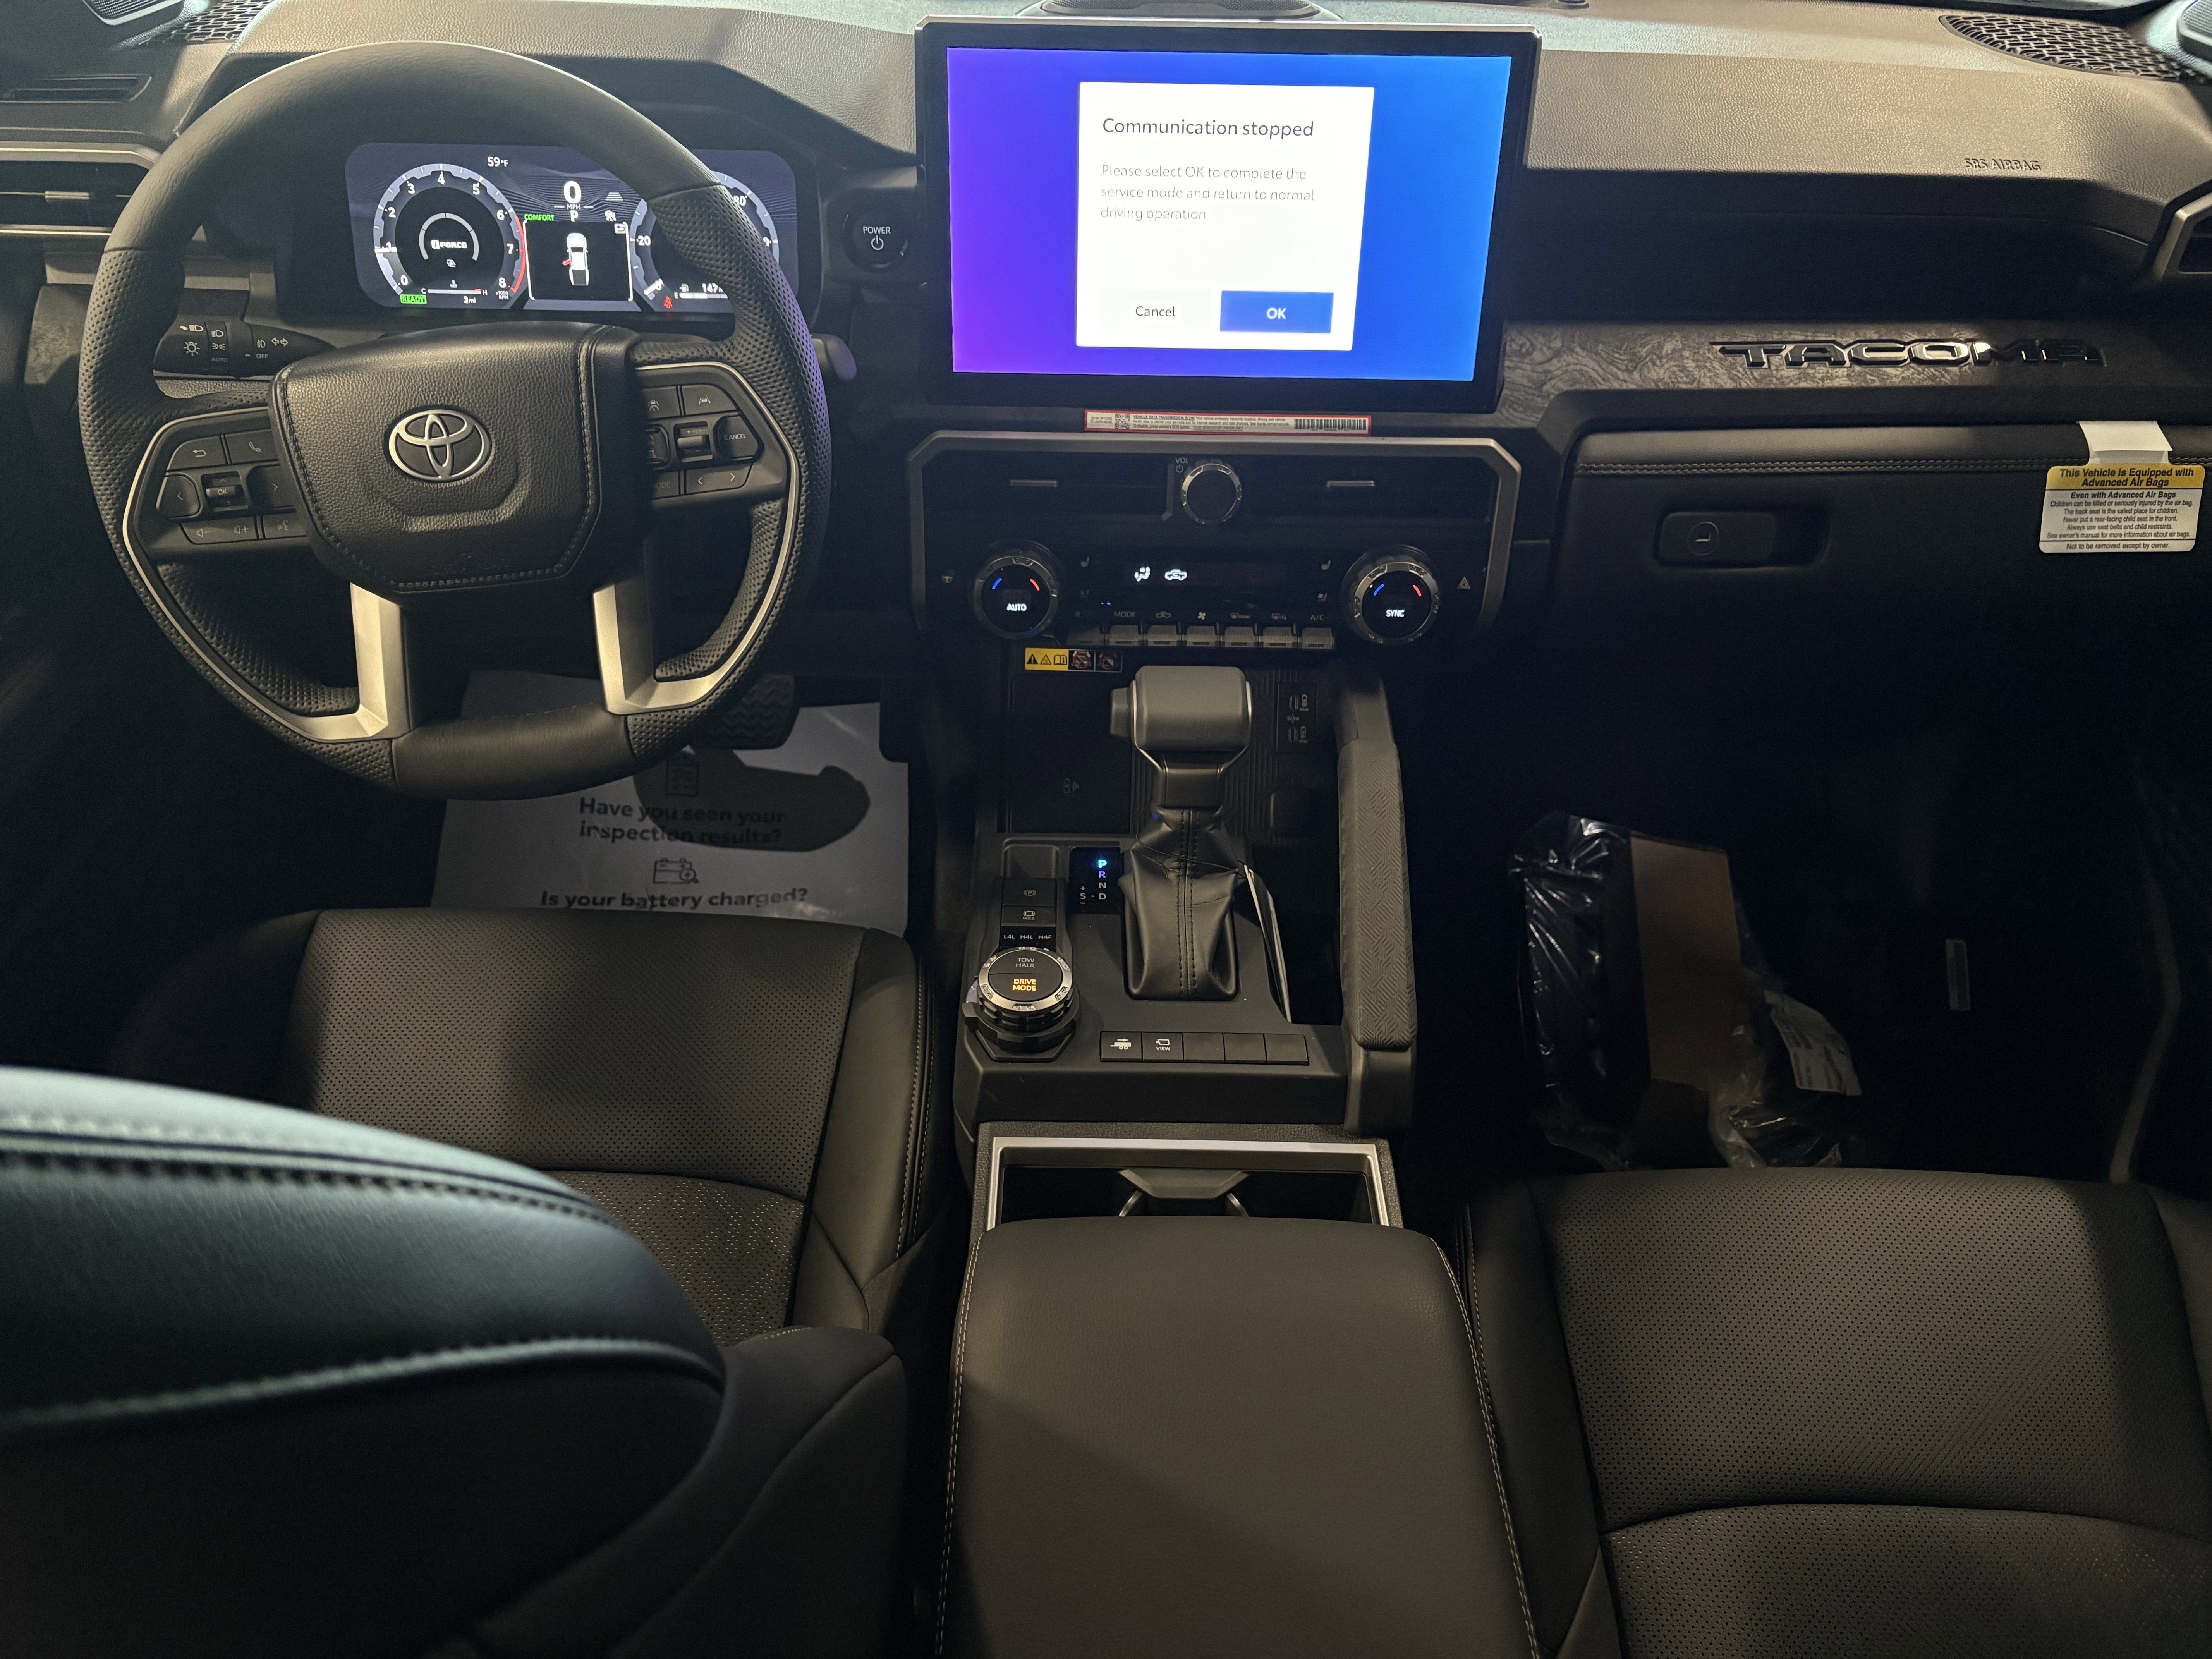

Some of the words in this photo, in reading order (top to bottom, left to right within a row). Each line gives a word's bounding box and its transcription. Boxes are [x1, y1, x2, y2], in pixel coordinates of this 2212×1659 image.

[1103, 118, 1238, 136] Communication
[1242, 121, 1314, 140] stopped
[1964, 158, 1988, 169] SRS
[1992, 158, 2041, 170] AIRBAG
[1102, 165, 1142, 177] Please
[1145, 166, 1182, 178] select
[1185, 166, 1204, 178] OK
[1208, 168, 1220, 178] to
[1224, 167, 1283, 181] complete
[1286, 168, 1306, 180] the
[437, 174, 445, 185] 4
[408, 183, 415, 194] 3
[472, 184, 480, 195] 5
[563, 180, 582, 204] 0
[1101, 186, 1144, 198] service
[1147, 187, 1183, 199] mode
[1187, 187, 1210, 199] and
[1214, 189, 1251, 200] return
[1255, 189, 1267, 200] to
[1271, 189, 1315, 201] normal
[389, 207, 396, 218] 2
[496, 210, 505, 220] 6
[570, 210, 579, 222] P
[1101, 207, 1143, 222] driving
[1146, 209, 1206, 221] operation
[863, 226, 891, 234] POWER
[638, 235, 651, 246] 20
[507, 244, 514, 254] 7
[400, 275, 409, 286] 0
[498, 277, 507, 288] 8
[1135, 306, 1176, 318] Cancel
[1266, 307, 1286, 319] OK
[1709, 339, 2107, 369] TACOMA
[2060, 468, 2080, 477] This
[2083, 468, 2116, 477] Vehicle
[2118, 468, 2126, 477] is
[2129, 468, 2173, 479] Equipped
[2175, 468, 2194, 477] with
[2081, 478, 2128, 487] Advanced
[2130, 477, 2144, 486] Air
[2145, 478, 2169, 488] Bags
[2158, 491, 2176, 499] Bags
[1006, 603, 1027, 611] AUTO
[1386, 609, 1405, 617] SYNC
[580, 796, 633, 817] Have
[638, 805, 677, 822] you
[684, 808, 732, 821] seen
[737, 811, 783, 827] your
[580, 820, 694, 843] inspection
[700, 828, 783, 845] results?
[1098, 859, 1108, 868] P
[542, 890, 559, 907] Is
[565, 894, 616, 910] your
[621, 891, 702, 911] battery
[708, 887, 809, 908] charged?
